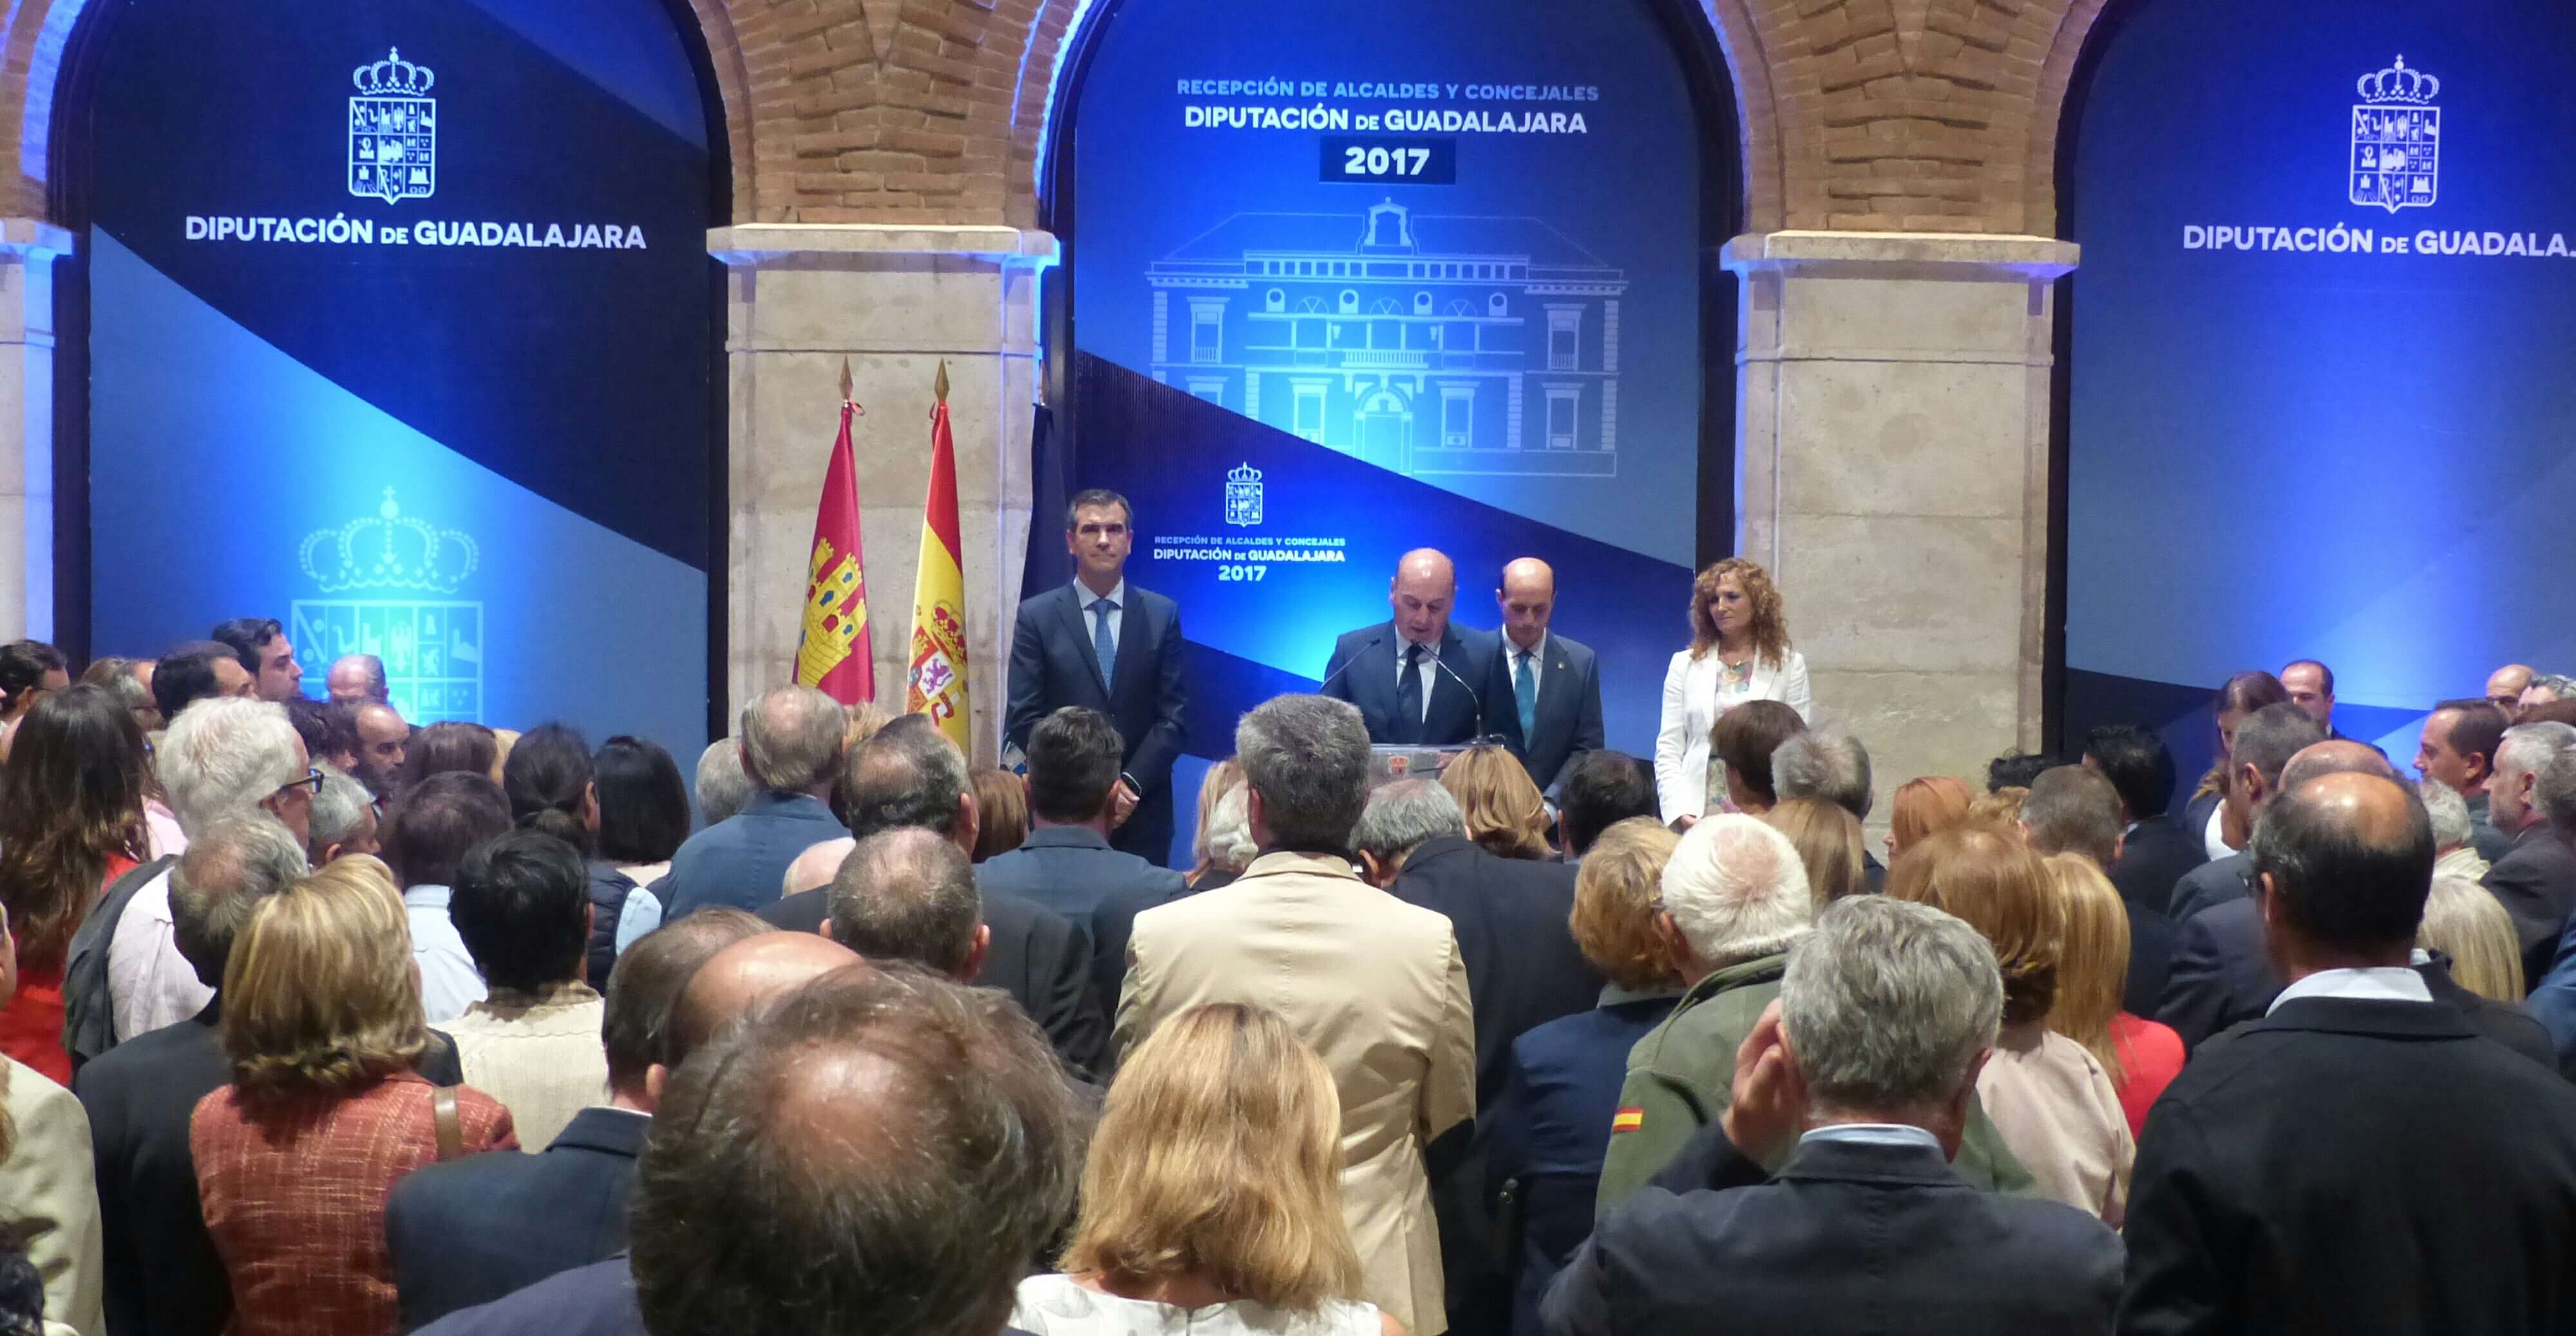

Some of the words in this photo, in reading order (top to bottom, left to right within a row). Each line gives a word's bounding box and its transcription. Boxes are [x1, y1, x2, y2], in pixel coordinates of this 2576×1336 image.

[1177, 75, 1294, 97] RECEPCIÓN
[1300, 81, 1327, 97] DE
[1333, 82, 1439, 99] ALCALDES
[1445, 84, 1459, 99] Y
[1464, 84, 1599, 101] CONCEJALES
[1185, 102, 1349, 130] DIPUTACIÓN
[1355, 115, 1379, 131] DE
[1384, 109, 1587, 133] GUADALAJARA
[1345, 146, 1430, 175] 2017
[186, 212, 373, 244] DIPUTACIÓN
[381, 227, 409, 245] DE
[413, 220, 647, 249] GUADALAJARA
[2184, 221, 2373, 253] DIPUTACIÓN
[2381, 236, 2409, 254] DE
[2414, 230, 2576, 258] GUADALA
[1154, 534, 1208, 545] RECEPCIÓN
[1210, 536, 1223, 545] DE
[1226, 537, 1274, 546] ALCALDES
[1284, 538, 1346, 547] CONCEJALES
[1153, 547, 1232, 561] DIPUTACIÓN
[1234, 552, 1246, 561] DE
[1248, 549, 1345, 562] GUADALAJARA
[1218, 565, 1267, 581] 2017
